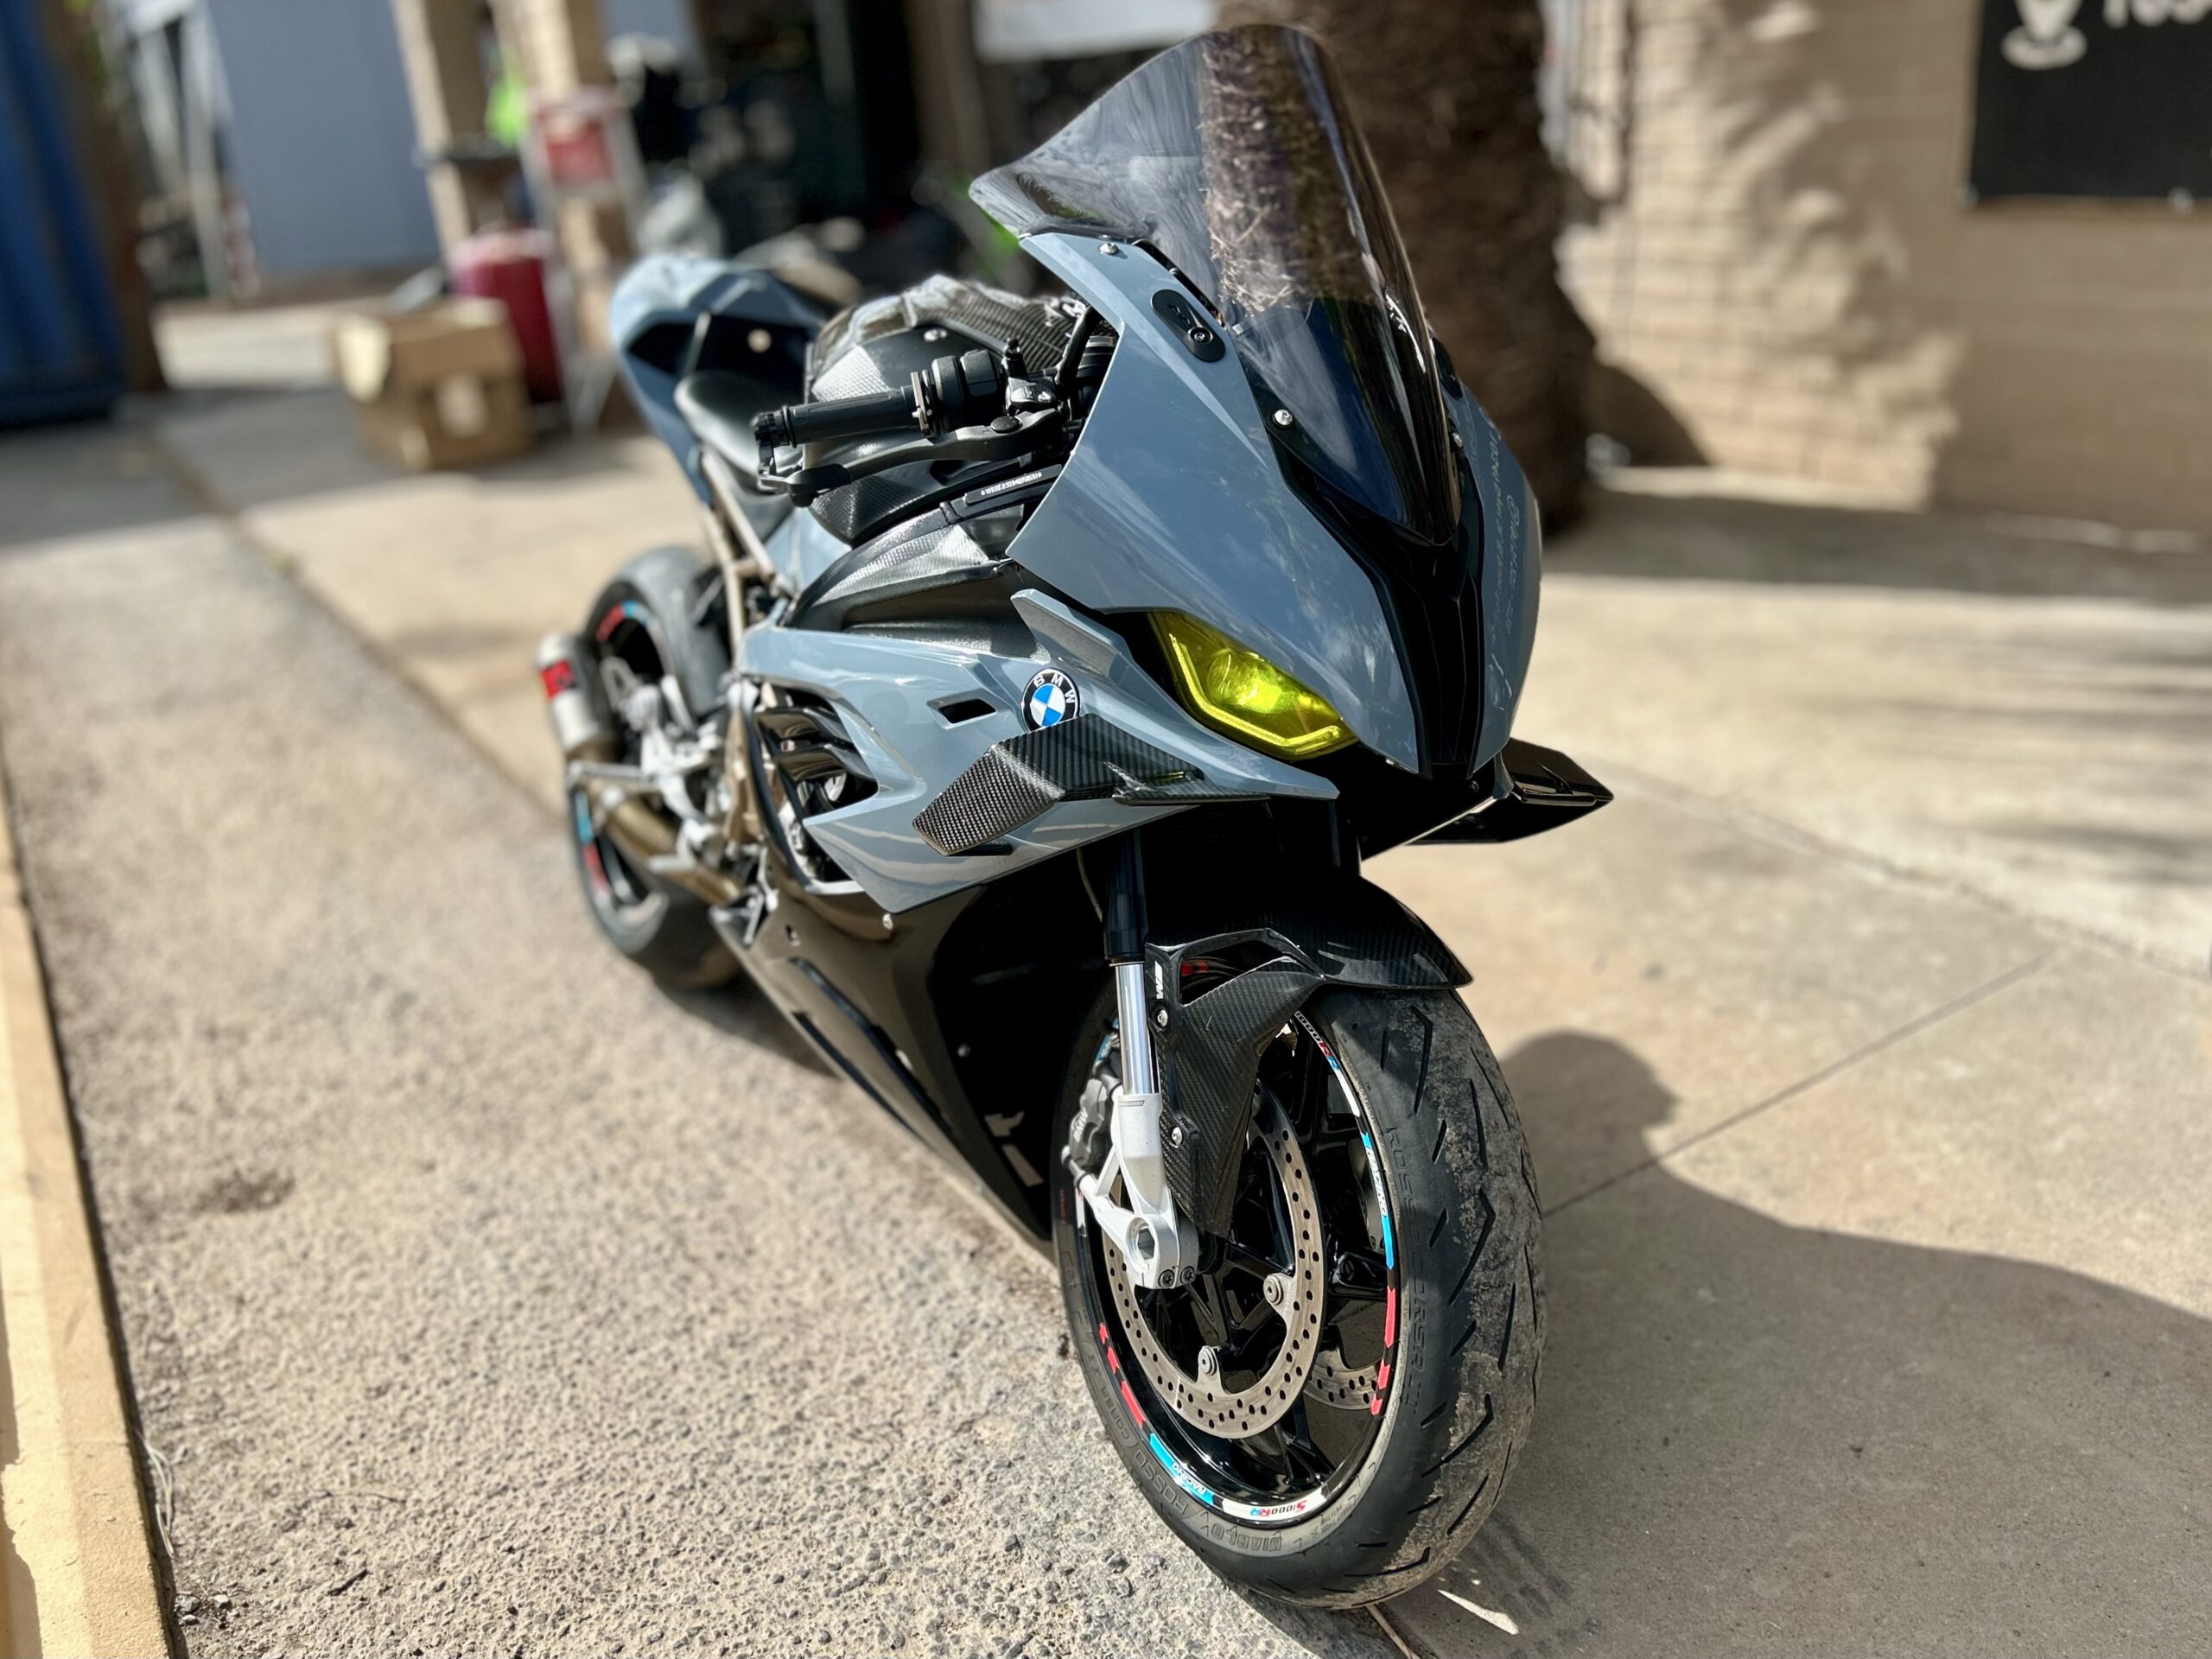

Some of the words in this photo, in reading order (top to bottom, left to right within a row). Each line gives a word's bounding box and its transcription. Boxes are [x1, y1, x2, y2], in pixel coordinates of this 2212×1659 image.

[1033, 673, 1076, 704] BMW
[1295, 1010, 1340, 1071] 1000RR
[1073, 1107, 1089, 1142] BMW
[1134, 1449, 1189, 1516] ROSSO
[1171, 1461, 1207, 1497] RACING
[1249, 1499, 1307, 1517] S1000RR
[1211, 1523, 1282, 1553] DIABLO
